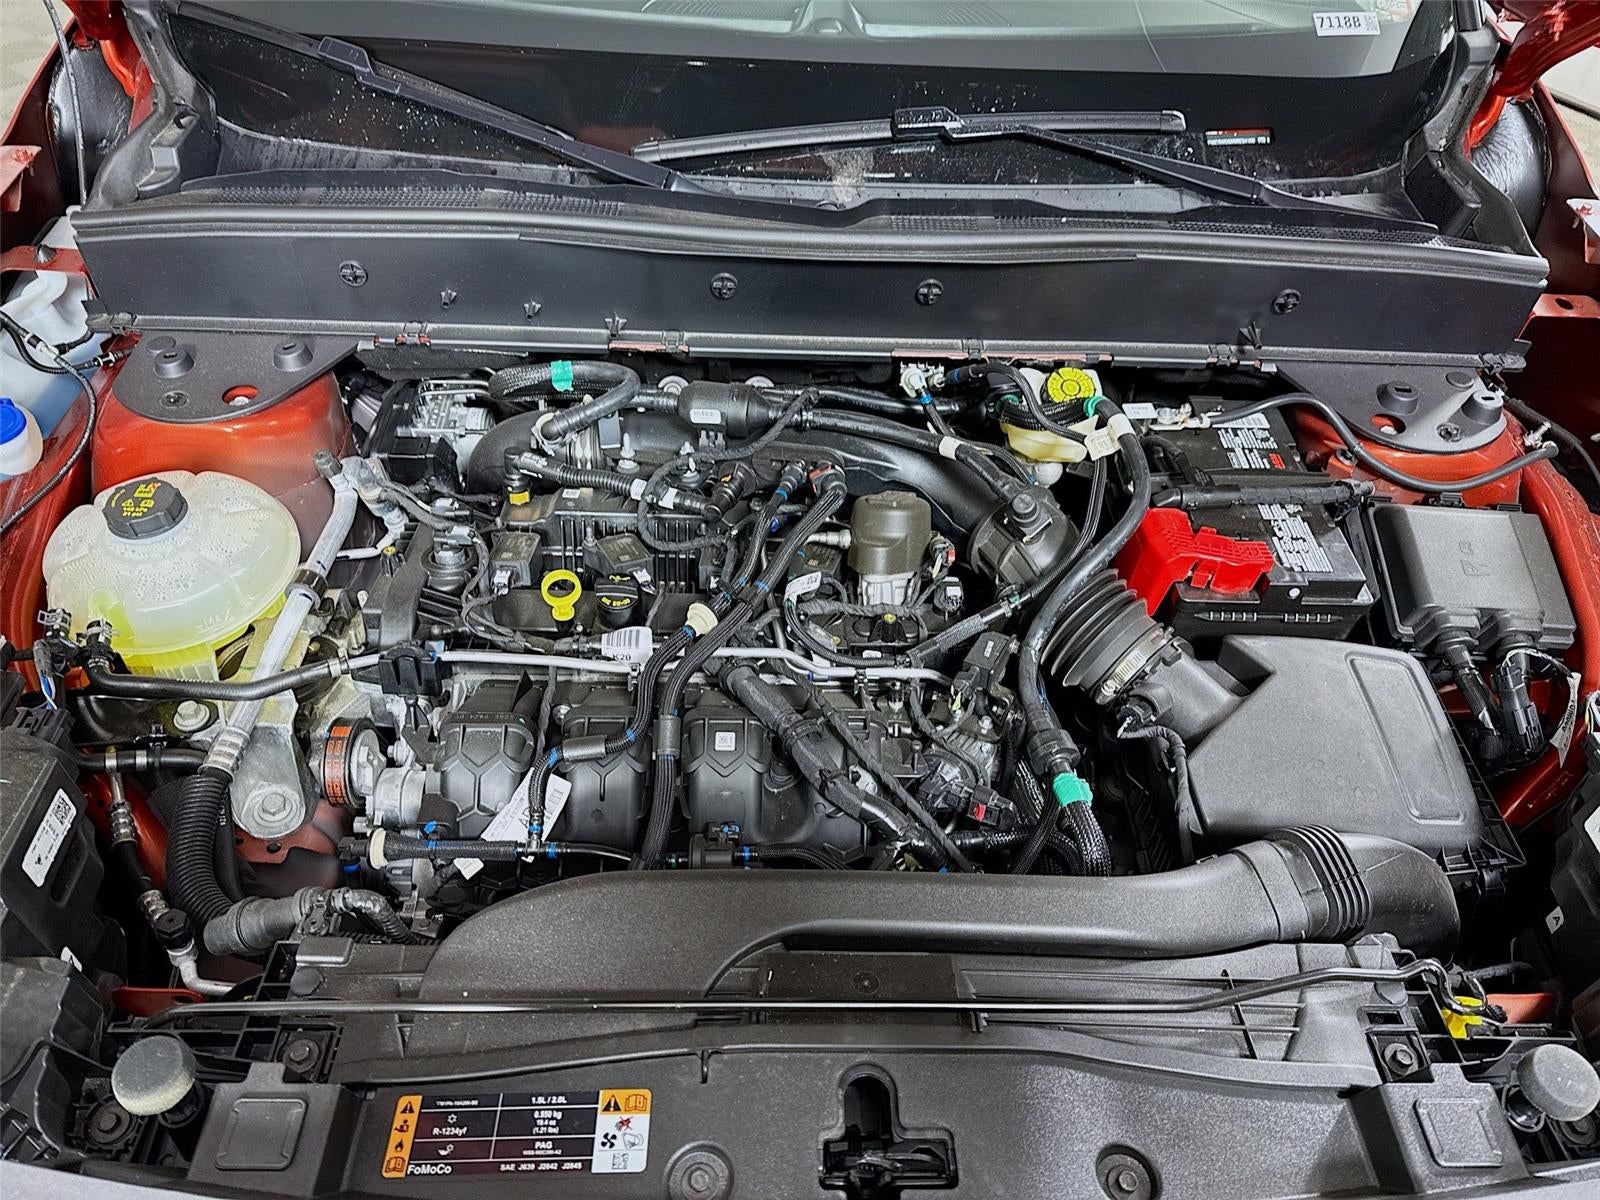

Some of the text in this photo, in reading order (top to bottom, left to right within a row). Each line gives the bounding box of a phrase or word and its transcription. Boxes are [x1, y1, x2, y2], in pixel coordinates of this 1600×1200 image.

[1552, 916, 1561, 926] A
[551, 1095, 568, 1104] 2.0L
[552, 1110, 563, 1120] kg
[432, 1126, 468, 1137] R-1234yf
[534, 1140, 553, 1149] PAG
[407, 1164, 452, 1175] FoMoCo
[500, 1163, 516, 1172] SAE
[518, 1162, 536, 1171] J639
